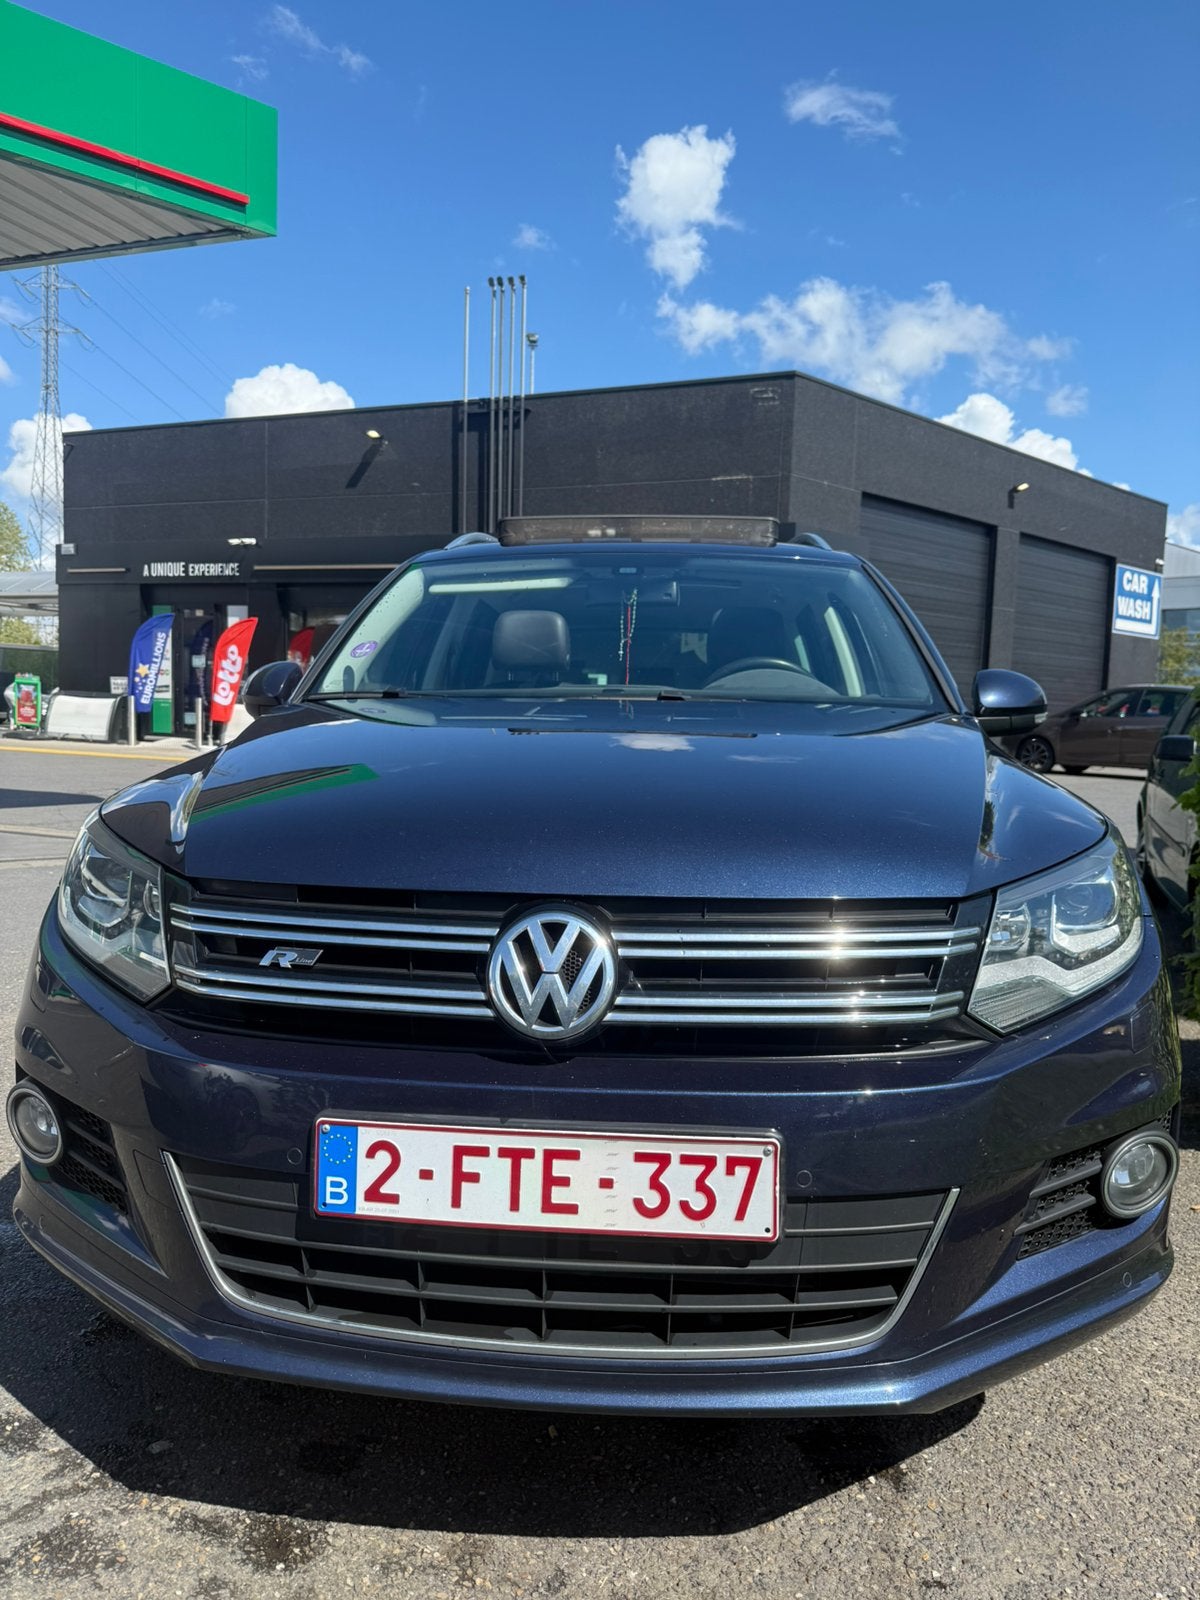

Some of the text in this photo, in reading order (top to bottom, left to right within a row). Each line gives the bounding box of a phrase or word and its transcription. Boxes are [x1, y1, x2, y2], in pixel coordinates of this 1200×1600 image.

[143, 562, 240, 577] A UNIQUE EXPERIENCE
[1122, 570, 1149, 595] CAR
[1117, 595, 1152, 620] WASH
[140, 631, 167, 705] EUROMILLIONS
[258, 949, 298, 968] R
[325, 1175, 349, 1205] B
[363, 1139, 763, 1222] 2-FTE-337
